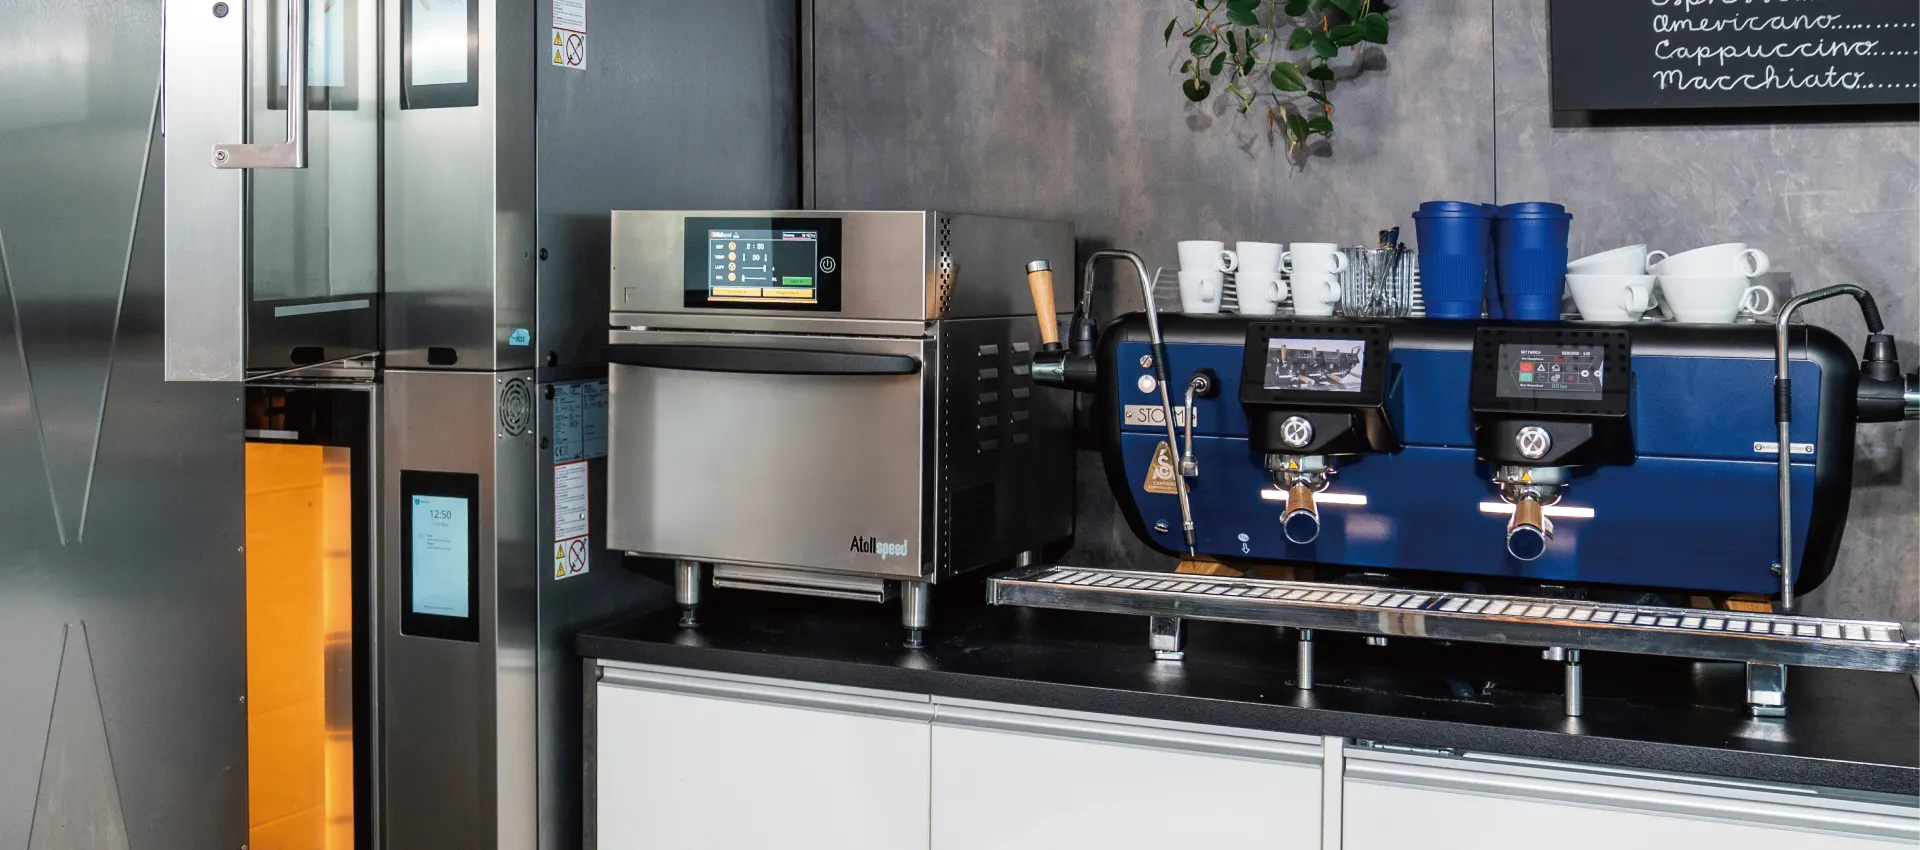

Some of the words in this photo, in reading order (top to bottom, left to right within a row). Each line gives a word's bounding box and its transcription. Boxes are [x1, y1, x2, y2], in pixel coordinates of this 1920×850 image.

[1137, 408, 1184, 424] STOM
[429, 509, 452, 520] 12:50
[849, 535, 908, 560] Atollspeed
